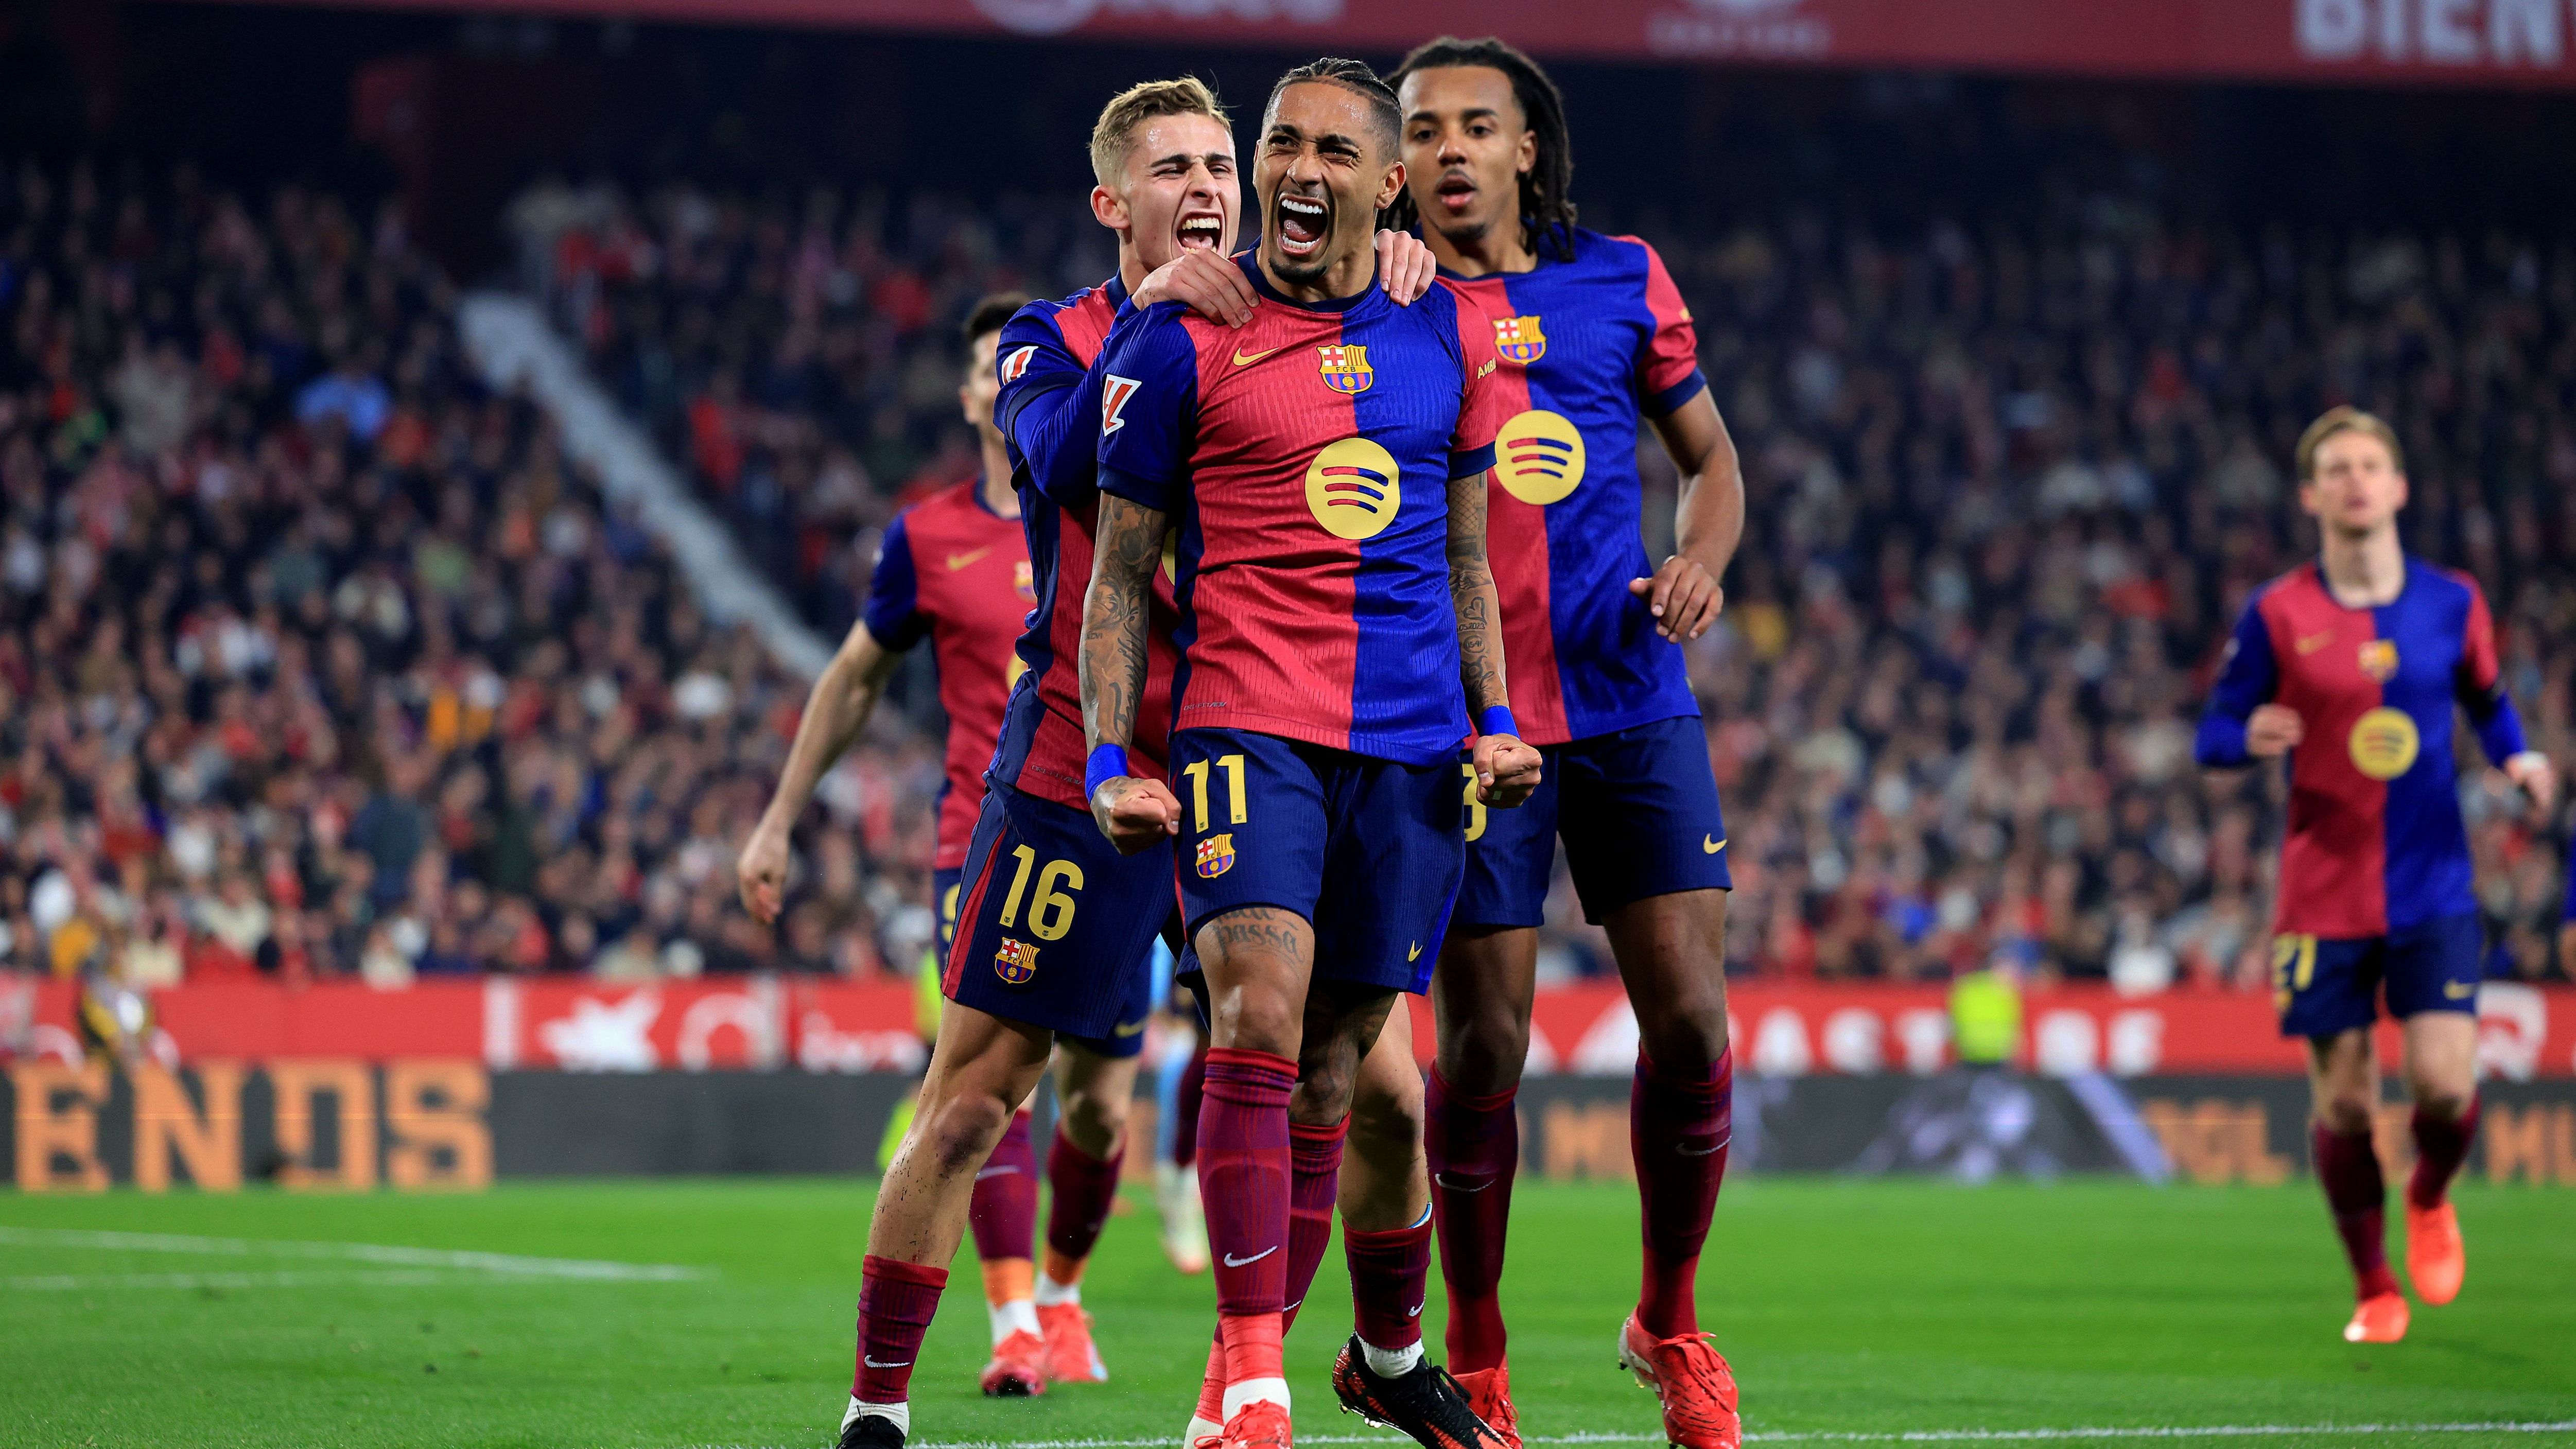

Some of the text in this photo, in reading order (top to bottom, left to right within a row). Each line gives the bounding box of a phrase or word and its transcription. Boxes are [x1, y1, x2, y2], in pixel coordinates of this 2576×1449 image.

[1183, 754, 1247, 834] 11
[999, 844, 1084, 941] 16
[1007, 957, 1023, 966] FCB
